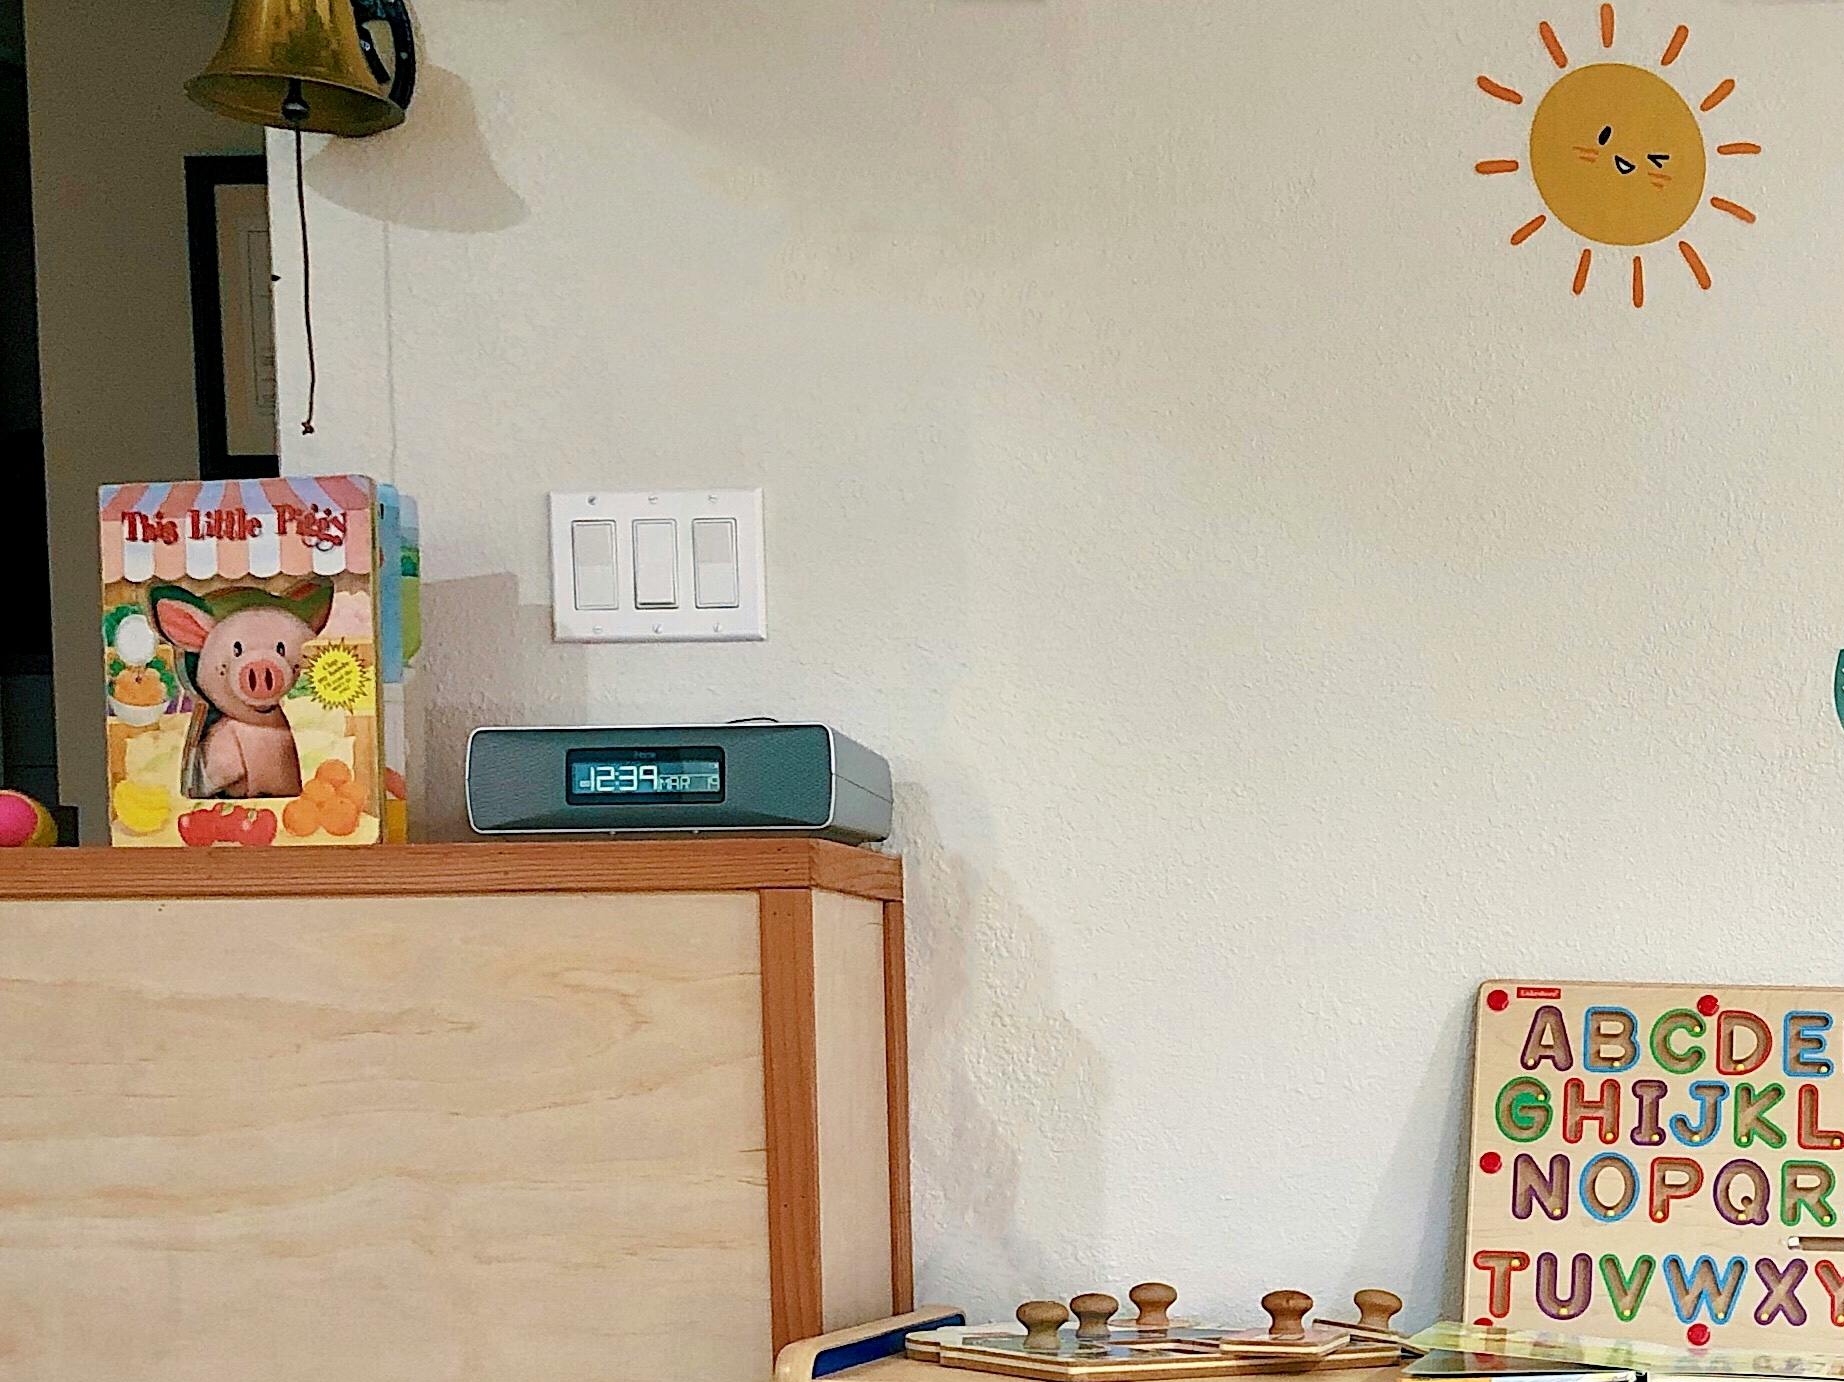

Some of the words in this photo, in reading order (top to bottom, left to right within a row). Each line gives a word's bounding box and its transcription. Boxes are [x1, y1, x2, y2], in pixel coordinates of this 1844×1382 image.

[122, 510, 179, 545] This
[188, 507, 263, 541] Little
[272, 503, 347, 551] Piggy
[589, 765, 658, 792] 12:39
[659, 776, 691, 790] MAR
